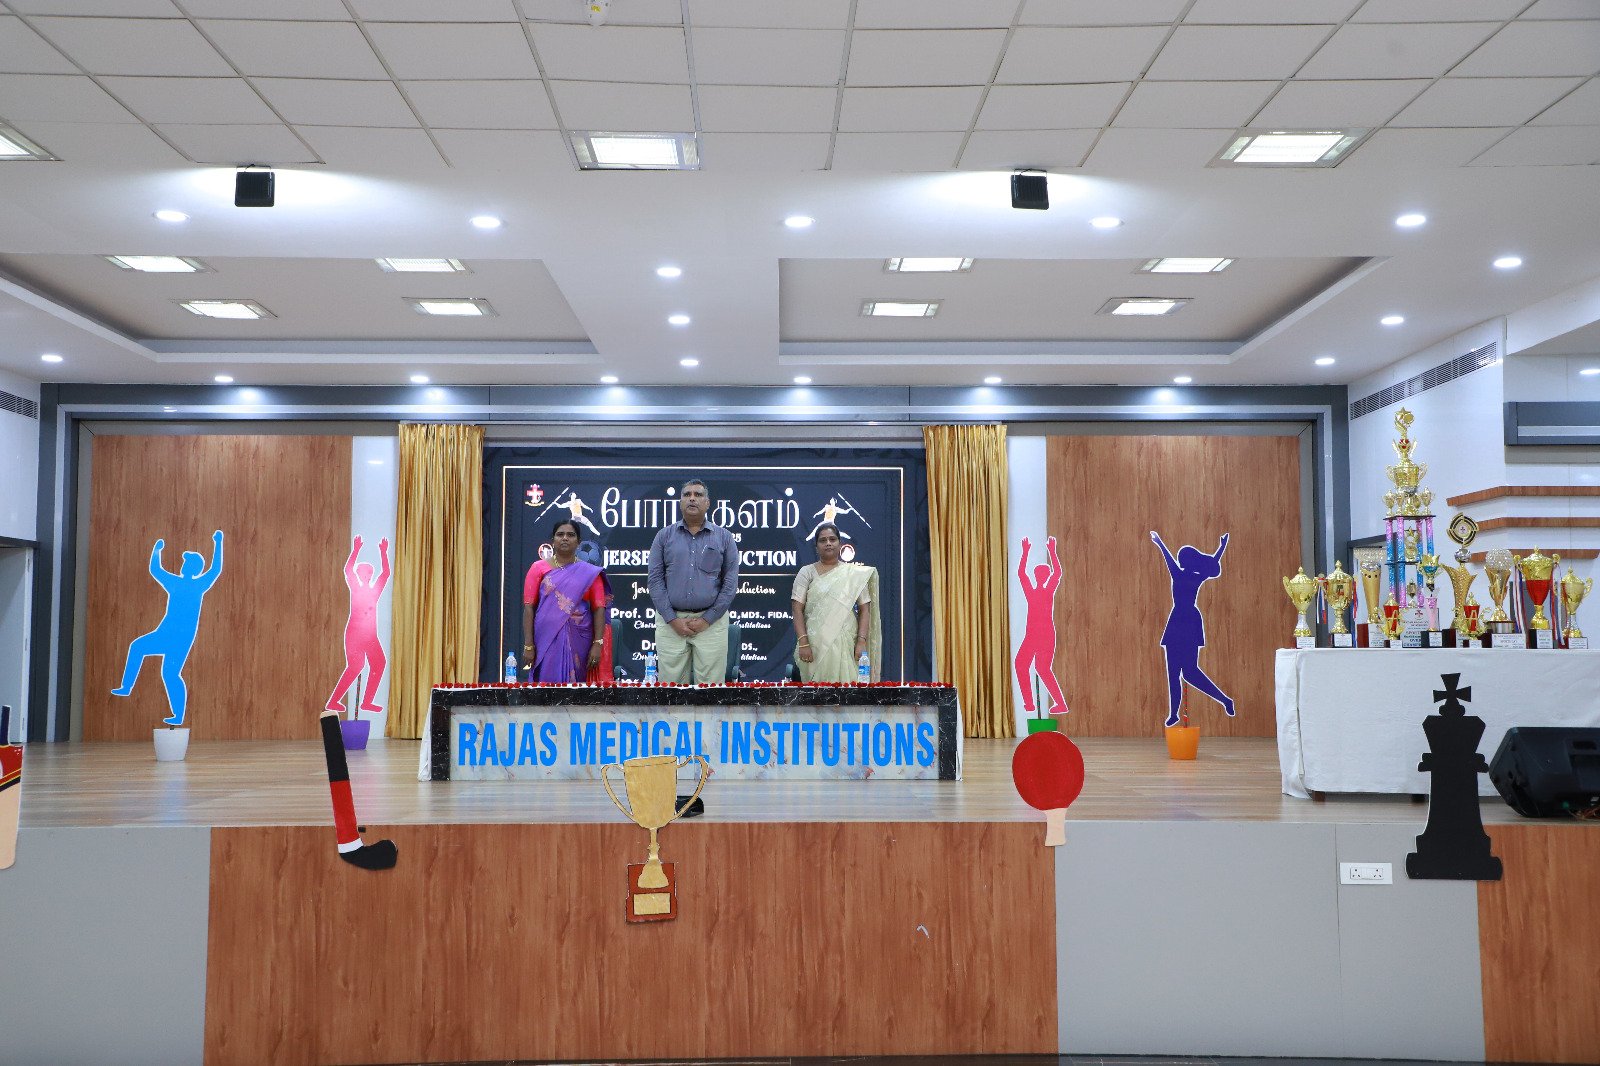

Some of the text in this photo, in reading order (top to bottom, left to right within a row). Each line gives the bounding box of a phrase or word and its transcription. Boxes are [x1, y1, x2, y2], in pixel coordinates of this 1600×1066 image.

[603, 549, 797, 569] JERSE UCTION
[610, 607, 641, 619] Prof.
[641, 639, 758, 651] Dr DS.,
[458, 720, 935, 767] RAJAS MEDICAL INSTITUTIONS
